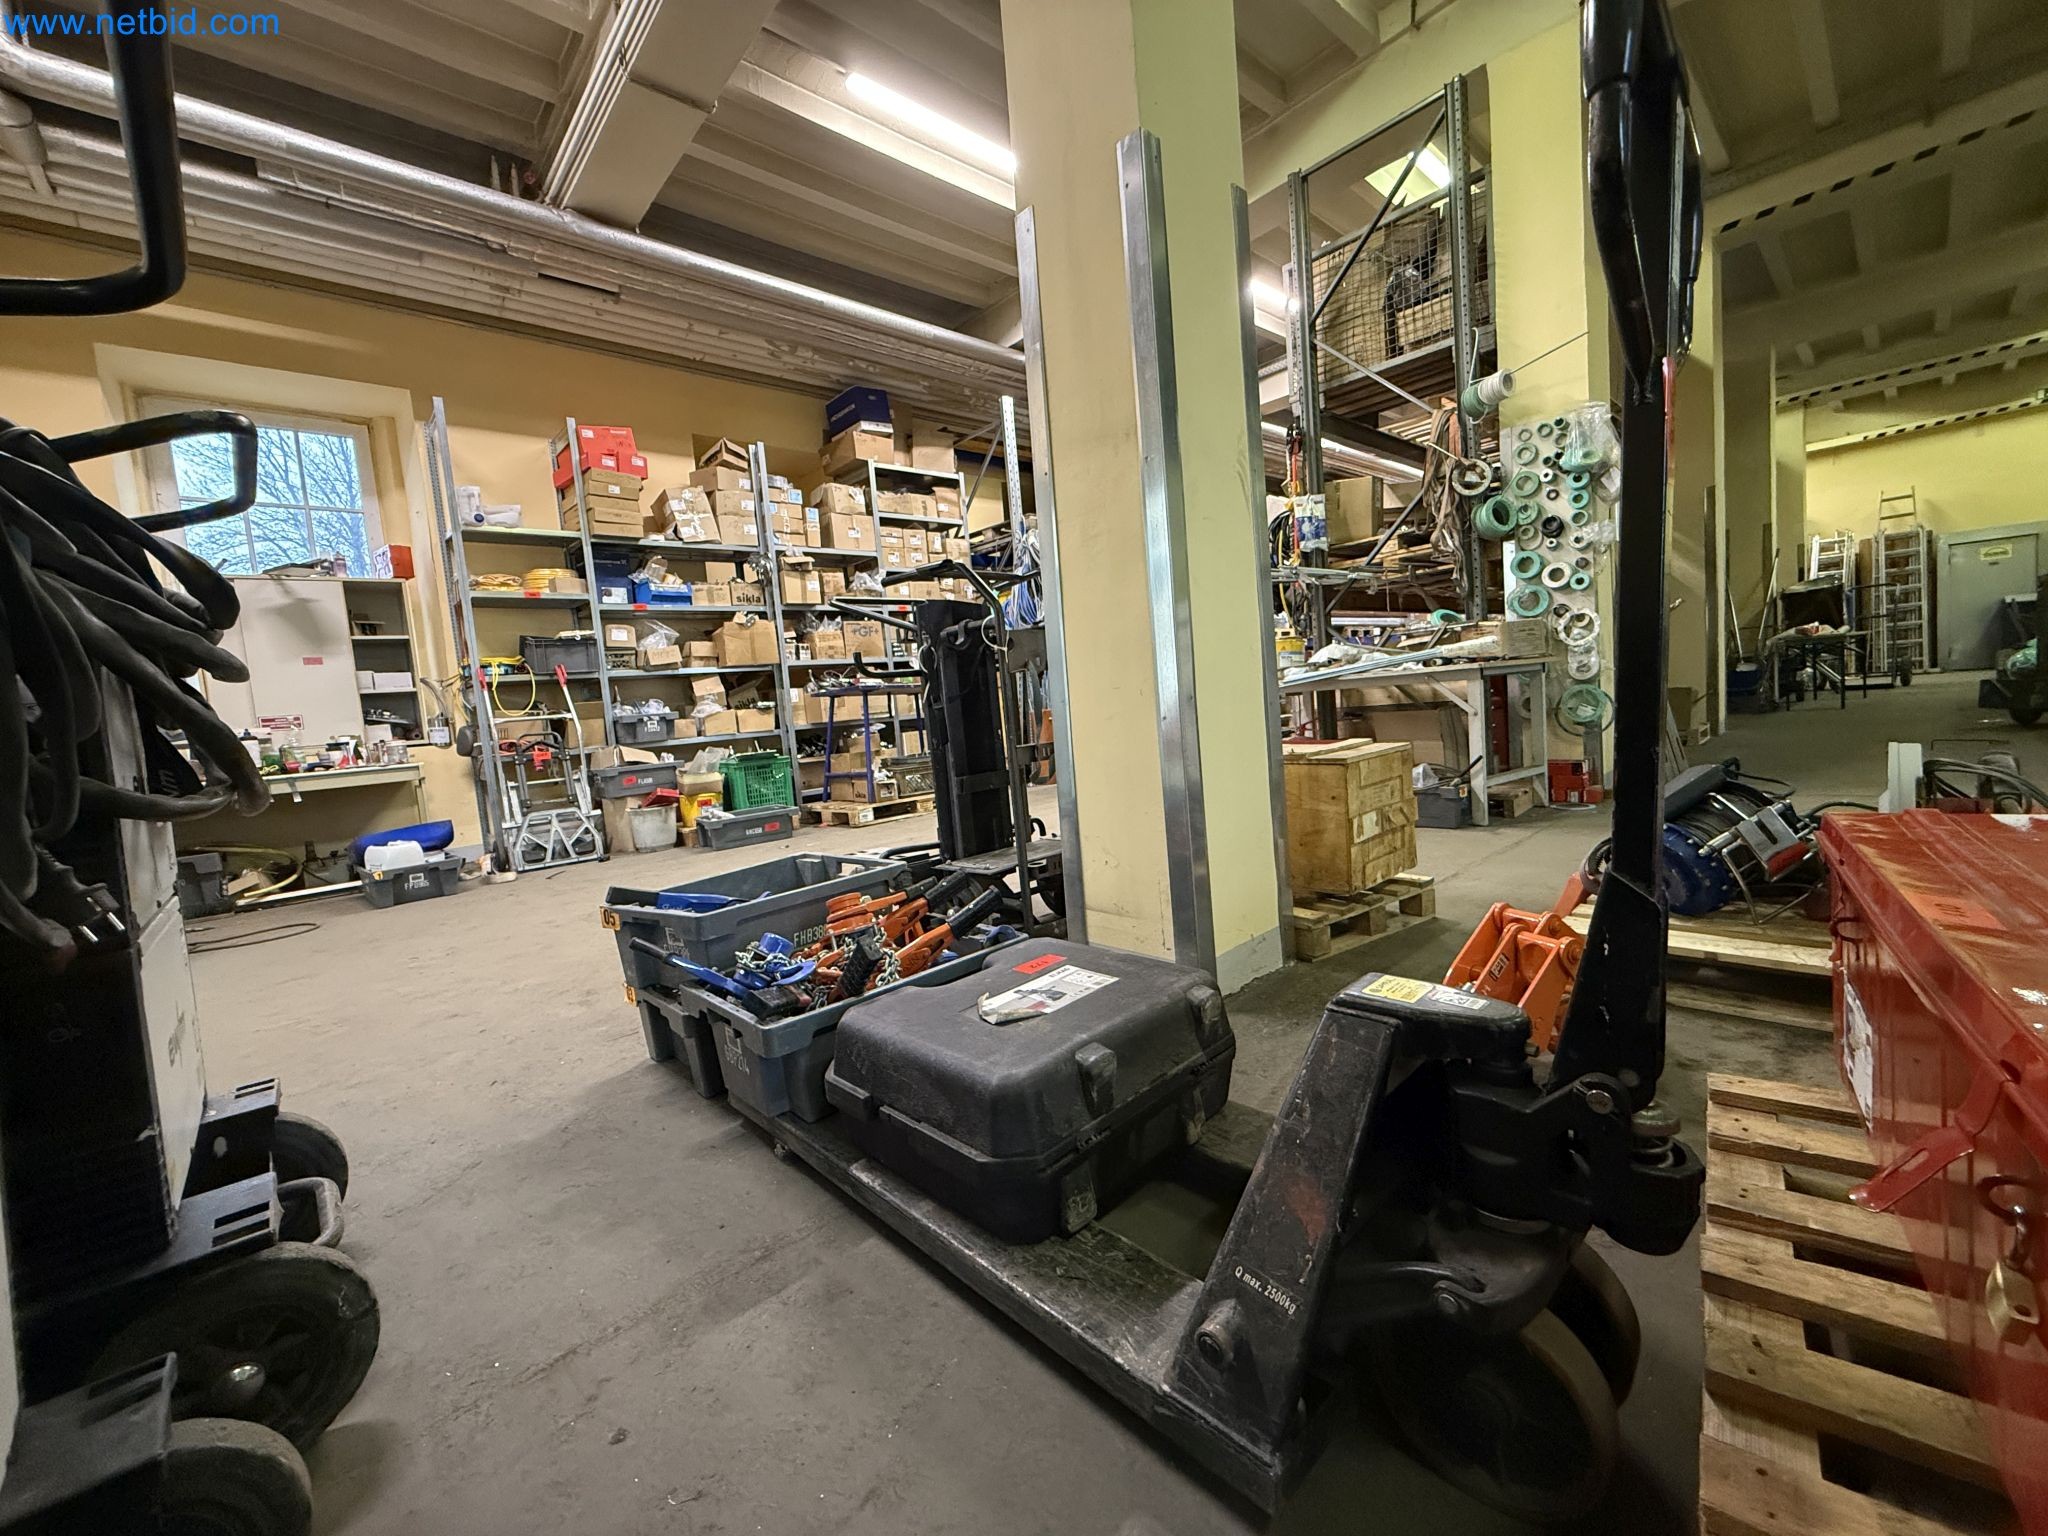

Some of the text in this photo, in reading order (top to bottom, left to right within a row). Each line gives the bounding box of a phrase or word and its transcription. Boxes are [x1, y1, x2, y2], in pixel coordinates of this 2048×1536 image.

[736, 592, 761, 604] sikla
[603, 909, 616, 926] 05
[1234, 1265, 1297, 1315] Q max. 2500kg
